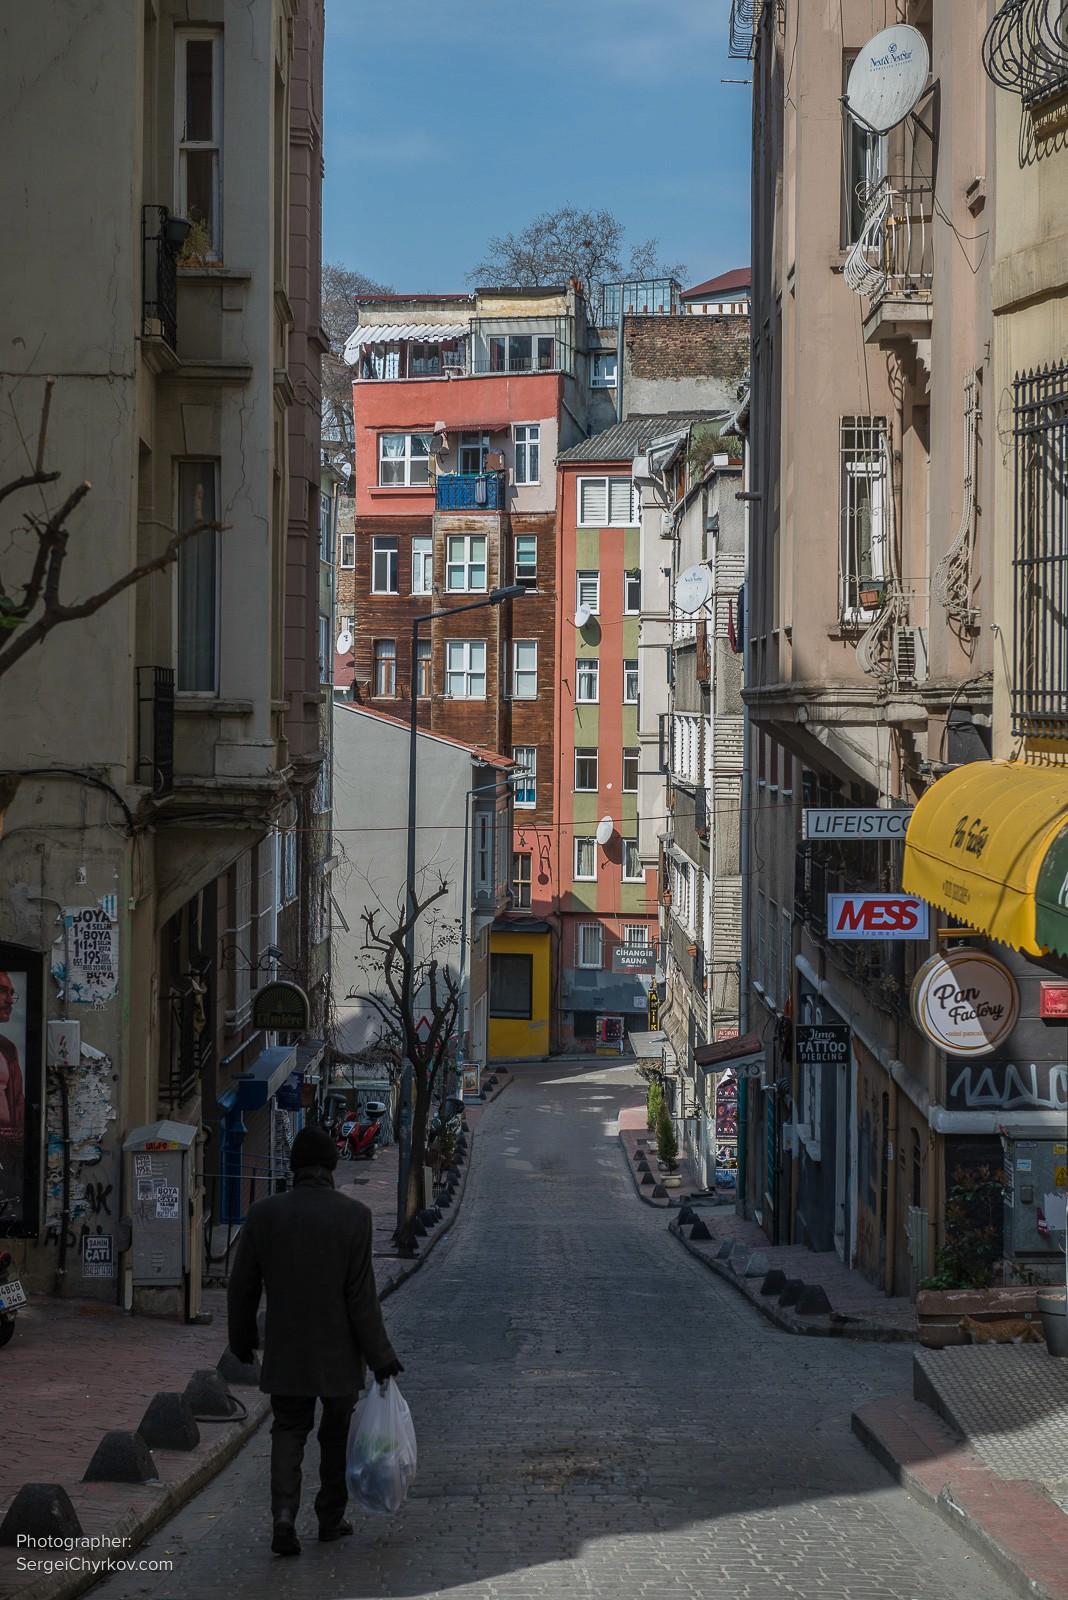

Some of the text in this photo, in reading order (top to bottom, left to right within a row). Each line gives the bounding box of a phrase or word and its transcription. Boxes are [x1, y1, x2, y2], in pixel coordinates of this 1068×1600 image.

[836, 900, 920, 930] MESS
[83, 931, 111, 940] BOYA
[83, 940, 97, 950] 1+1
[83, 950, 100, 965] 195
[621, 957, 648, 965] SAUNA
[933, 984, 980, 1010] Pan
[948, 1001, 1004, 1025] Factory
[798, 1041, 846, 1052] TATTOO
[6, 1293, 23, 1305] 346
